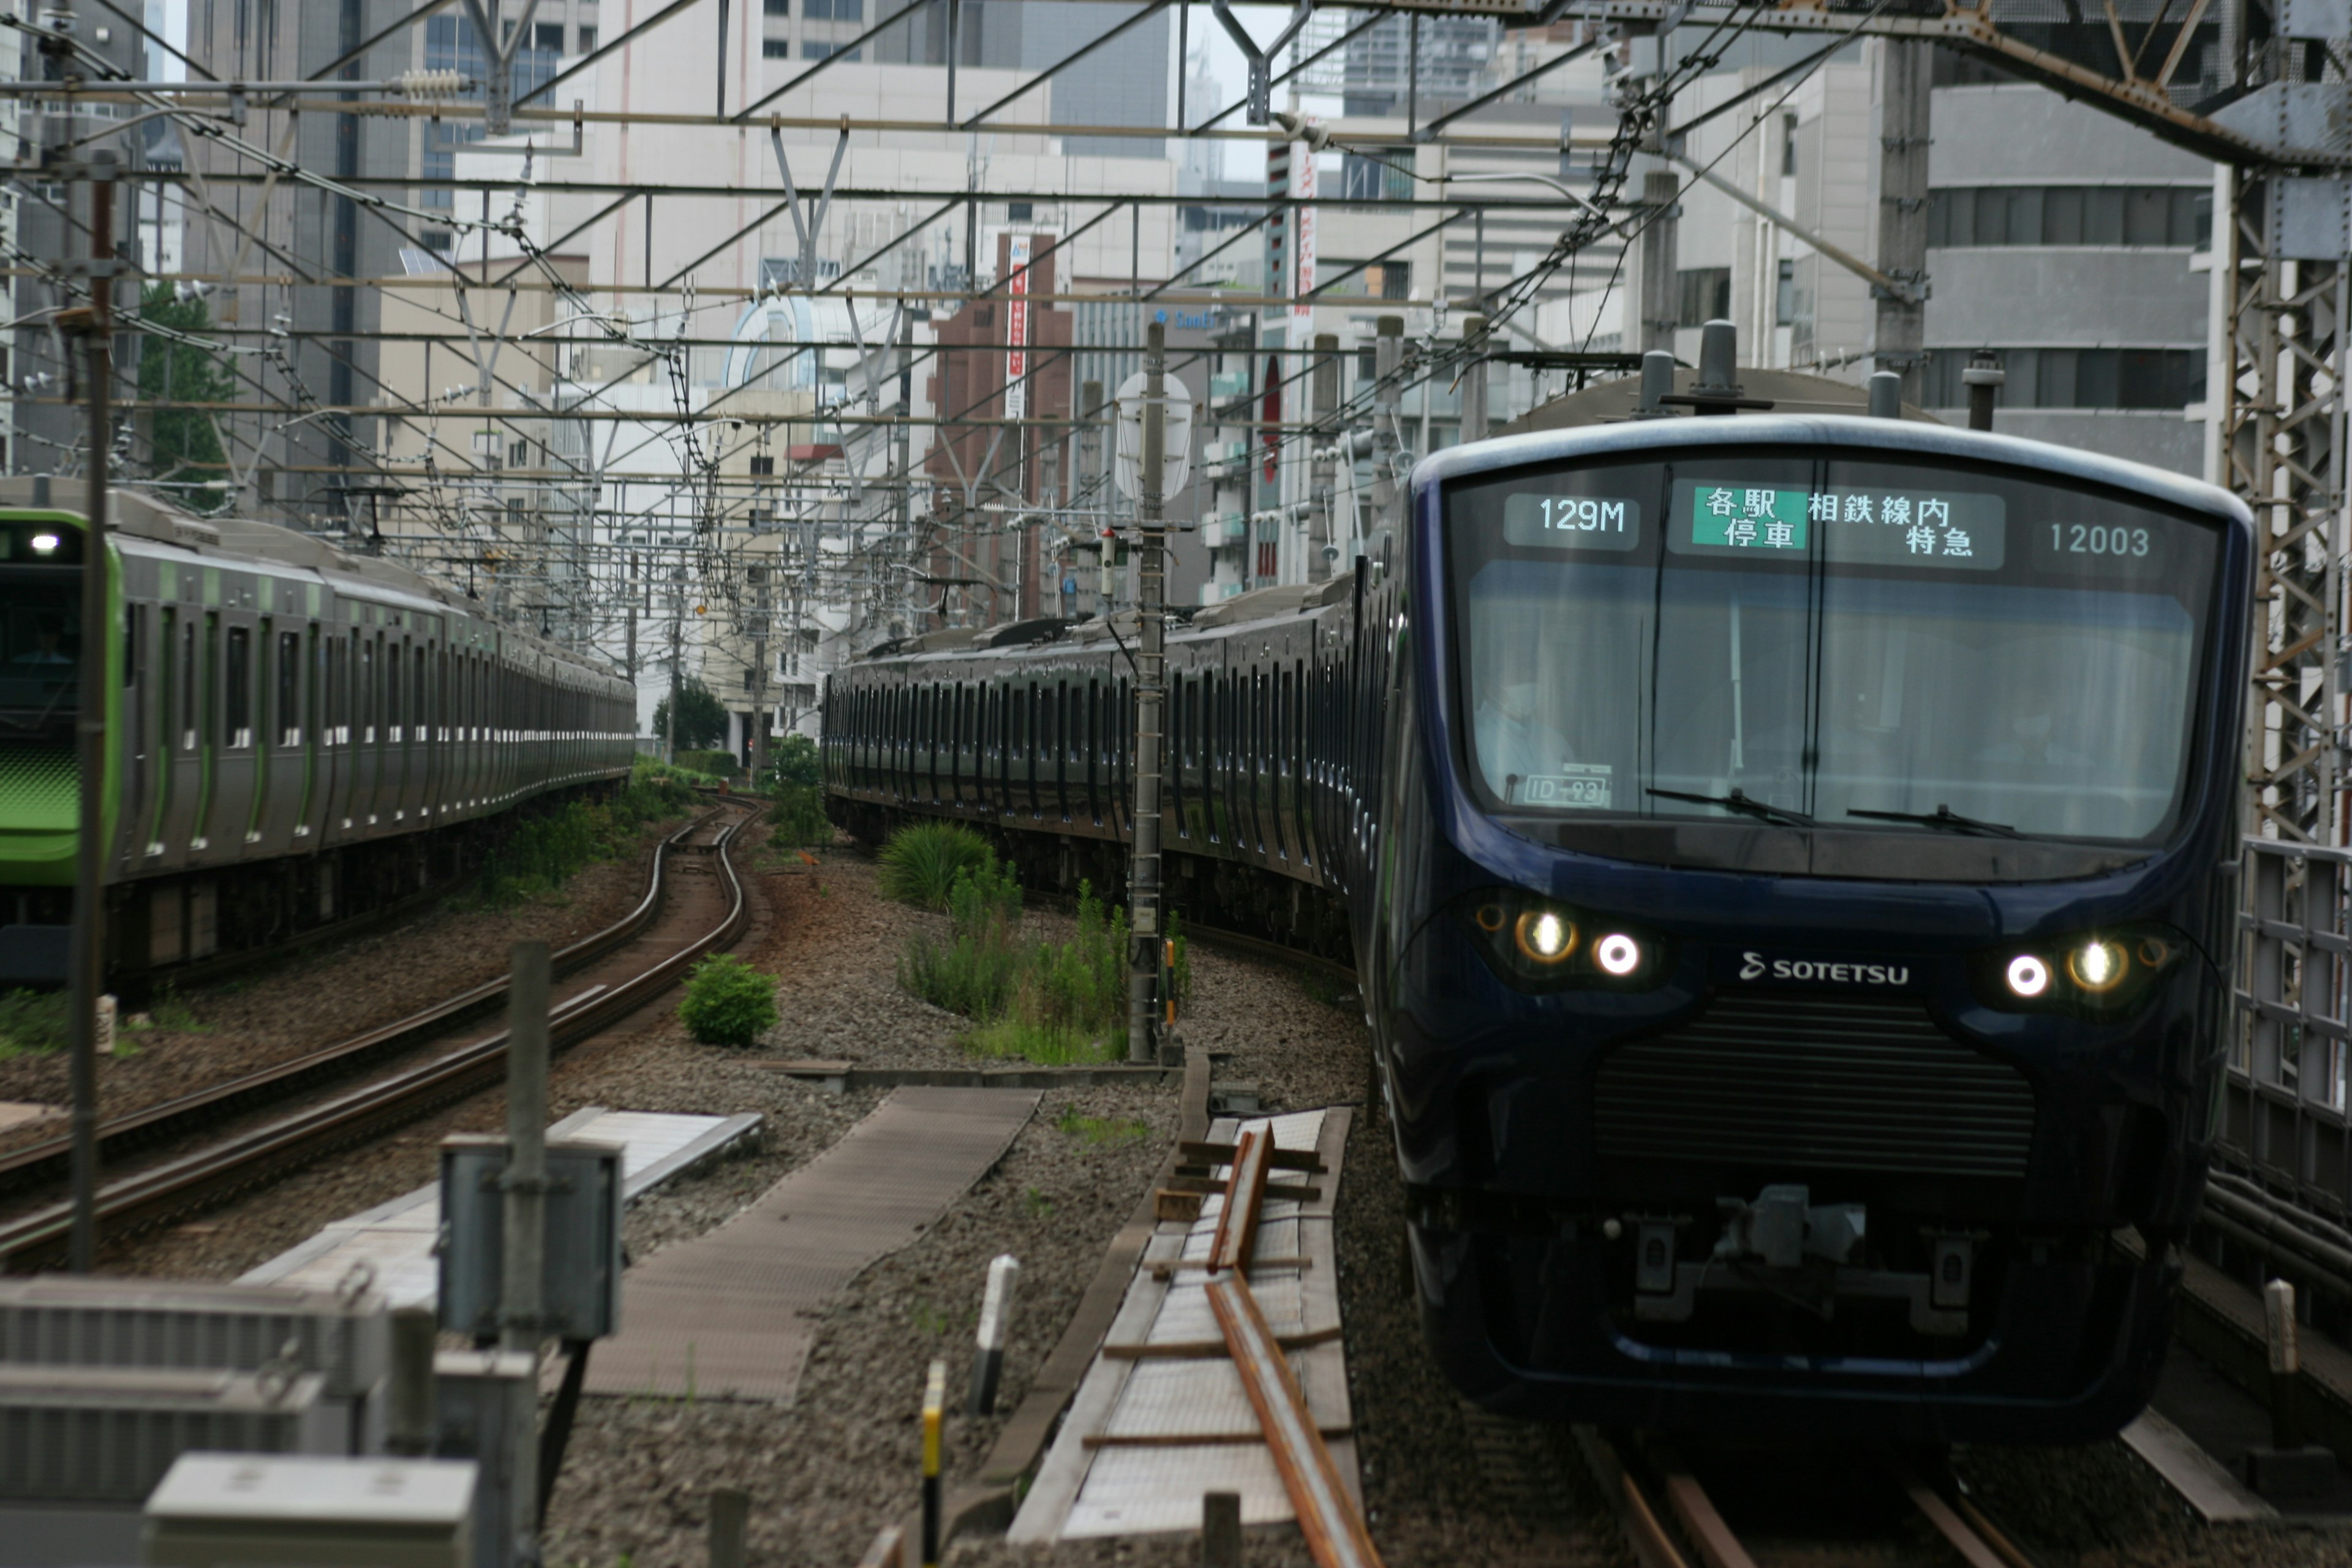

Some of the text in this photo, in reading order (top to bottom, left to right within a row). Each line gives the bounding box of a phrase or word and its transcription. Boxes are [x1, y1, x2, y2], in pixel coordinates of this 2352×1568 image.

[1540, 498, 1624, 533] 129M
[1706, 488, 1776, 519] 各駅
[1807, 492, 1950, 527] 相鉄線内
[1724, 518, 1795, 549] 停車
[1905, 525, 1973, 557] 特急
[2051, 523, 2149, 557] 12003
[1773, 959, 1909, 986] SOTETSU
